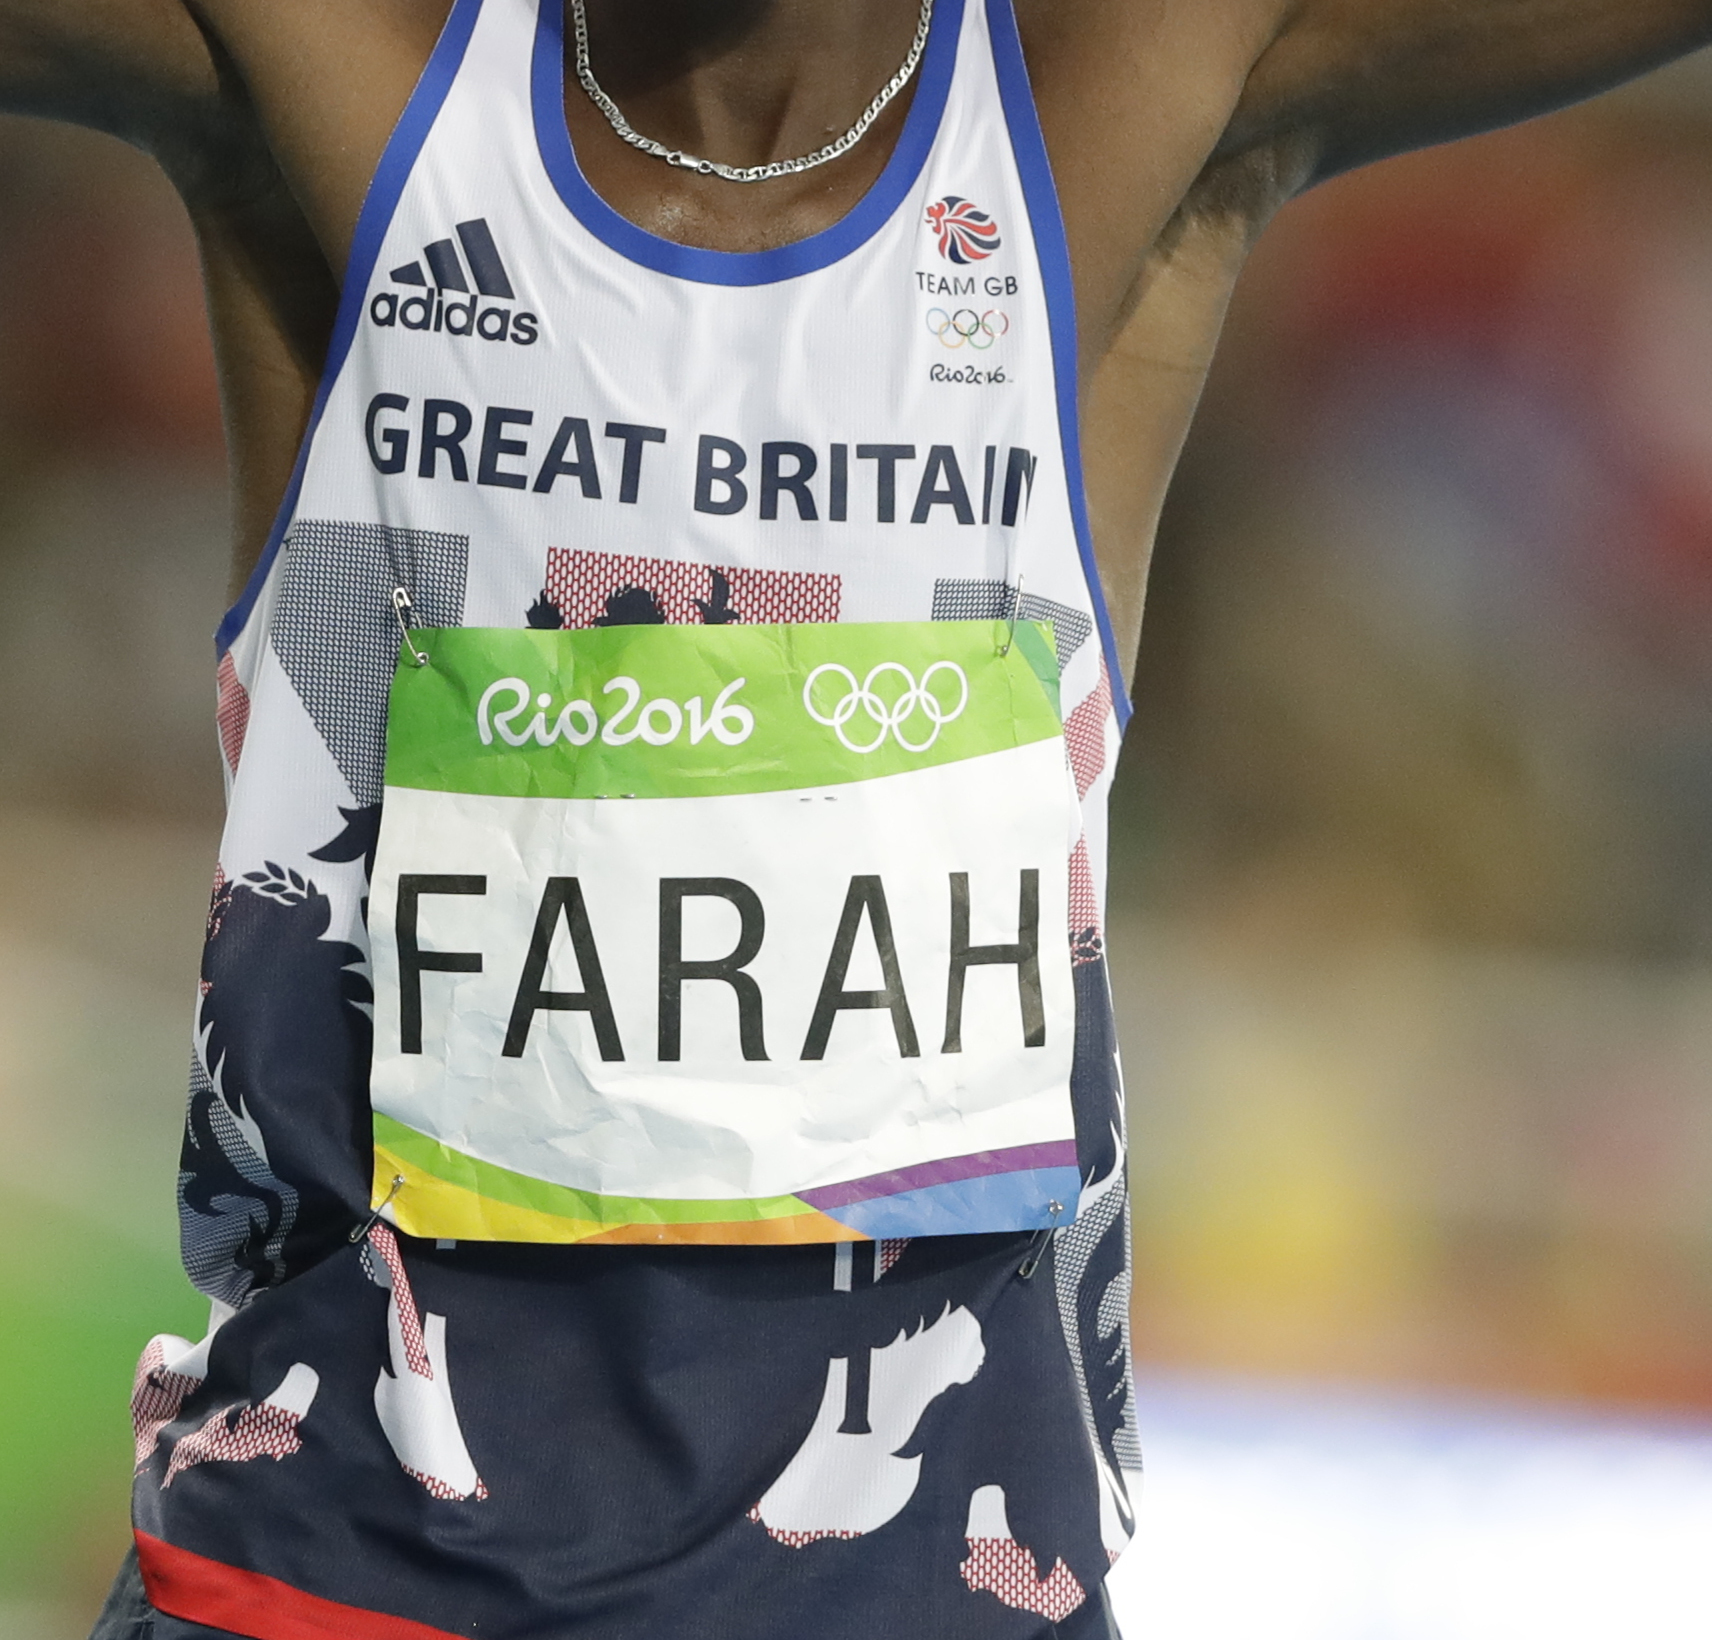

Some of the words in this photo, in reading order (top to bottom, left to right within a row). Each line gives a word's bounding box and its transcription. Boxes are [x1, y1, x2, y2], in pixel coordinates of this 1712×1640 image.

[369, 286, 540, 346] adidas
[915, 271, 976, 296] TEAM
[983, 274, 1019, 297] GB
[364, 391, 667, 505] GREAT
[692, 433, 1038, 528] BRITAIN
[476, 676, 756, 748] Rio2016
[394, 867, 1047, 1063] FARAH
